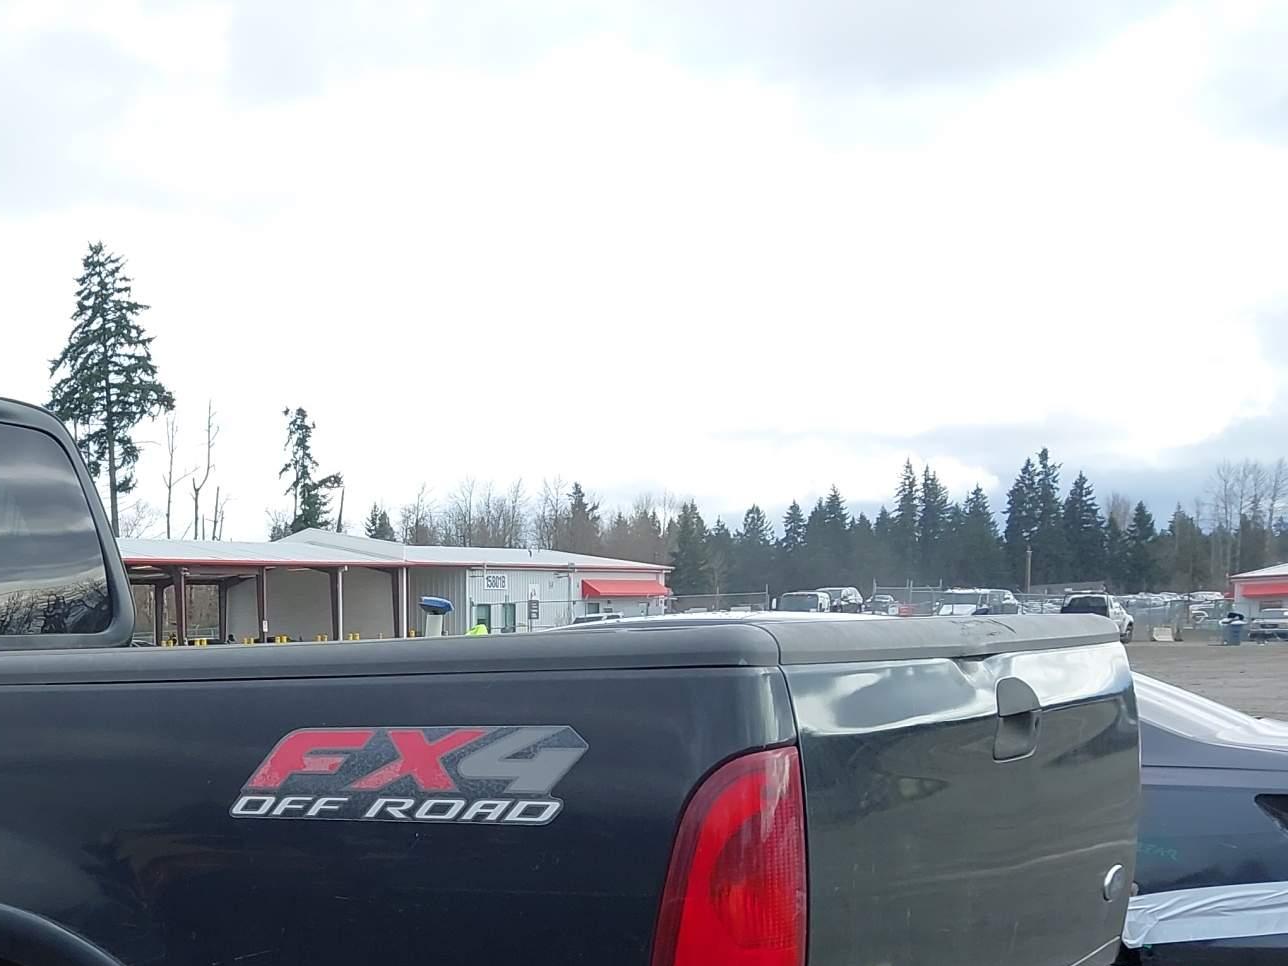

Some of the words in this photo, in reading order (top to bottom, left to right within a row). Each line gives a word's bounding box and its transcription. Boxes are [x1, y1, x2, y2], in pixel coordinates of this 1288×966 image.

[486, 575, 506, 588] 15801B
[246, 726, 588, 794] FX4
[231, 796, 349, 818] OFF
[364, 797, 564, 823] ROAD
